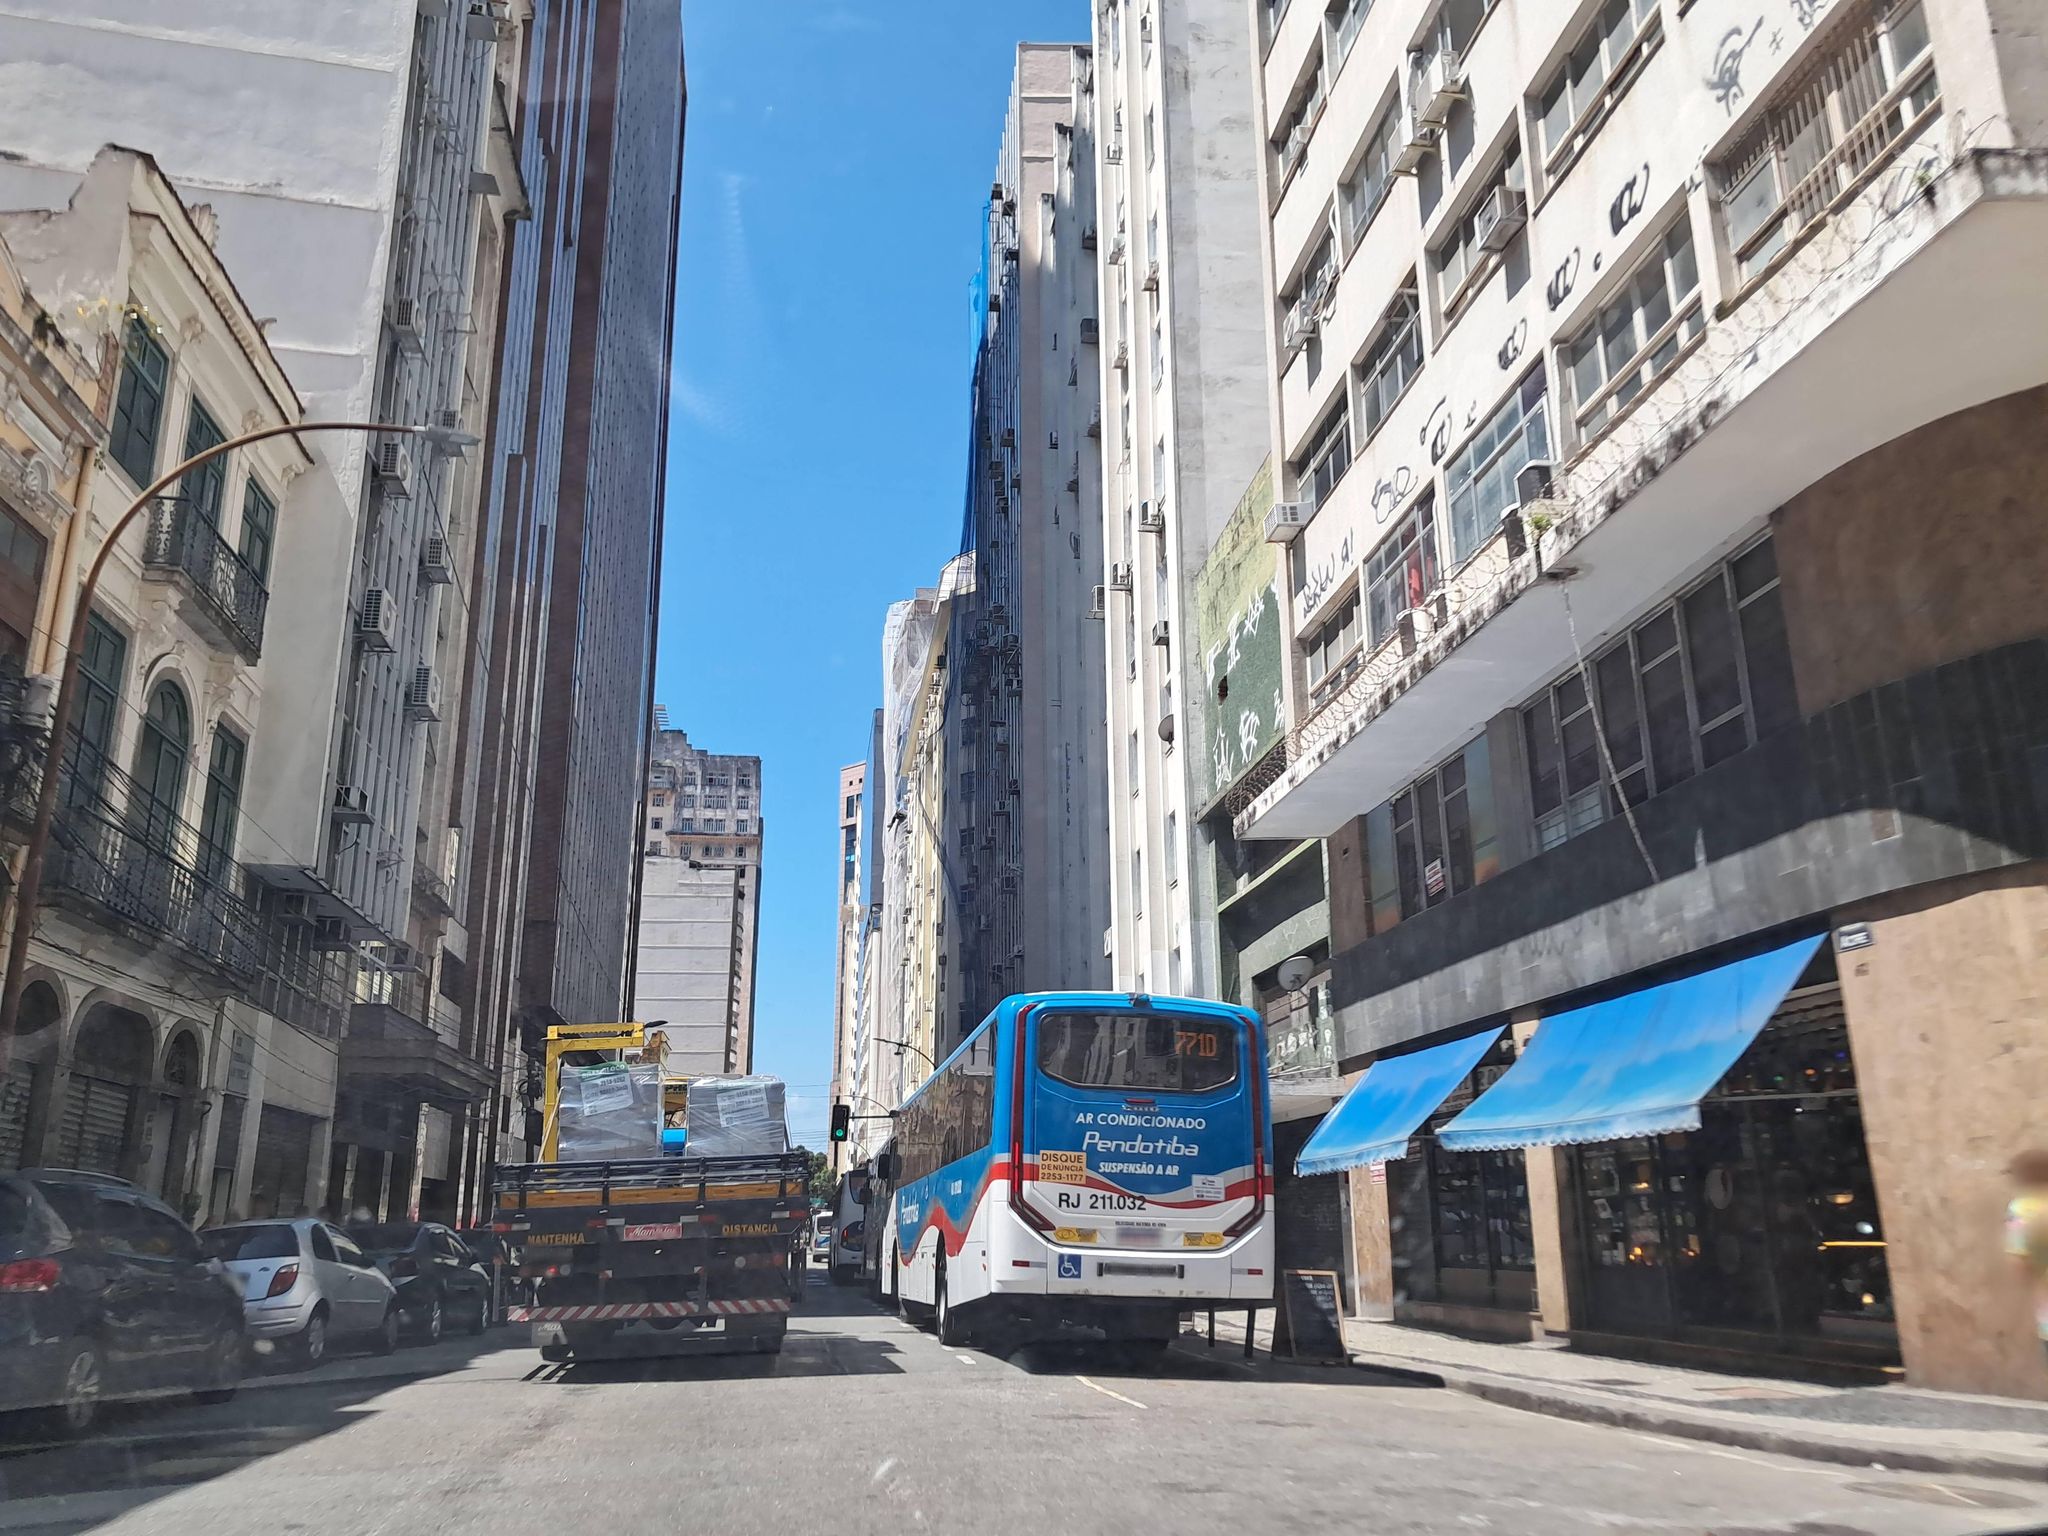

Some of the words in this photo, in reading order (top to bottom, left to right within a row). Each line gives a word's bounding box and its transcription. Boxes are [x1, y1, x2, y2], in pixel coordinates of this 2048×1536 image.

[1075, 1112, 1094, 1124] AR
[1097, 1113, 1206, 1130] CONDICIONADO
[1082, 1131, 1199, 1156] Pendotiba
[1041, 1153, 1084, 1164] DISQUE
[1099, 1162, 1154, 1174] SUSPENSÃO
[1155, 1164, 1164, 1175] A
[1165, 1165, 1180, 1176] AR
[1041, 1172, 1084, 1181] 2253-1177
[1058, 1193, 1081, 1208] RJ
[1089, 1194, 1147, 1210] 211.032
[527, 1232, 585, 1245] MANTENHA
